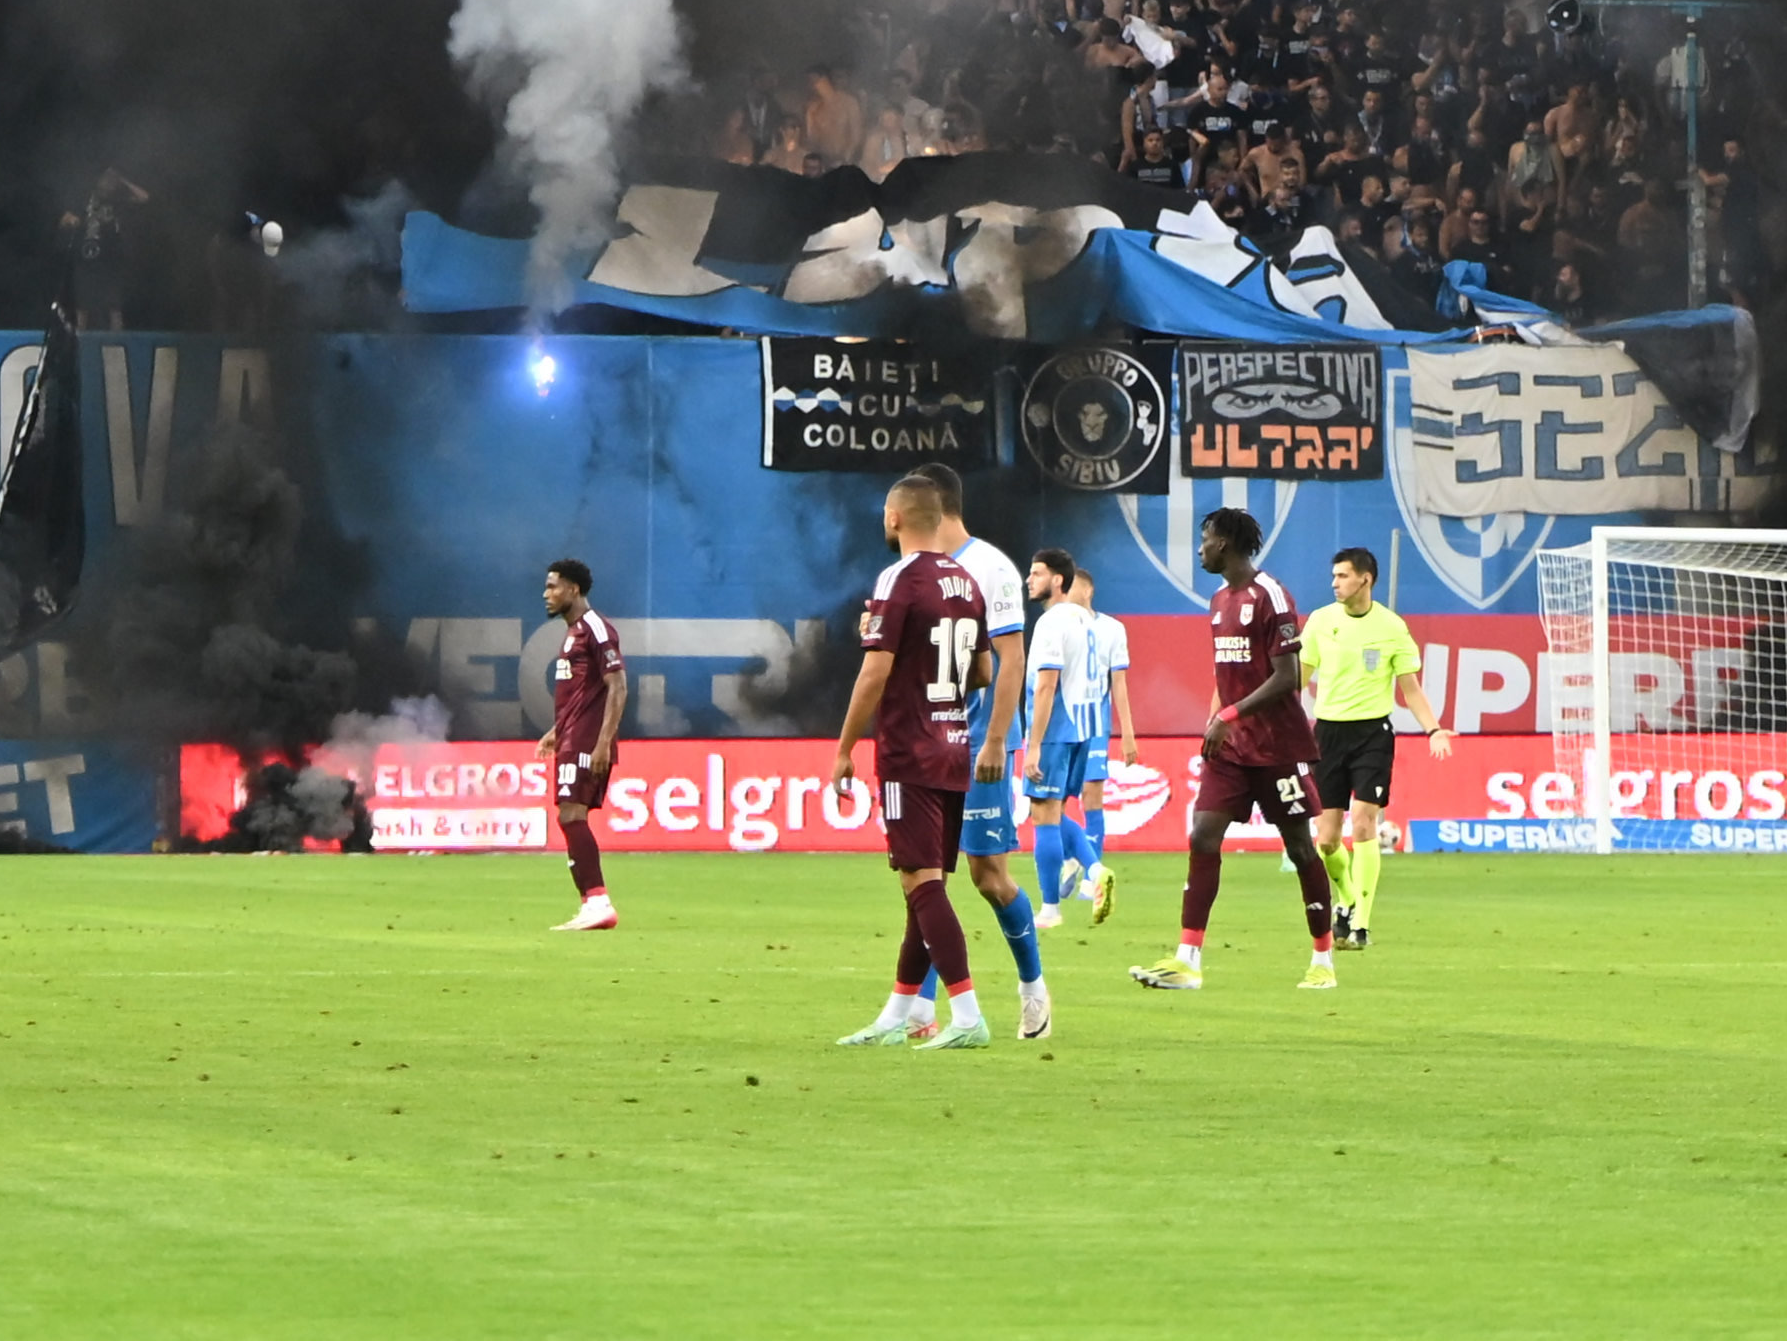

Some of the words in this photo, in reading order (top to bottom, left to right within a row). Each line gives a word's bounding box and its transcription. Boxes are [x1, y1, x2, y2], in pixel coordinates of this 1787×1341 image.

[1183, 350, 1378, 419] PERSPECTIVA
[1054, 452, 1120, 484] SIBIU
[373, 762, 548, 799] ELGROS
[557, 762, 578, 786] 10
[1275, 774, 1306, 803] 21
[433, 815, 452, 837] &
